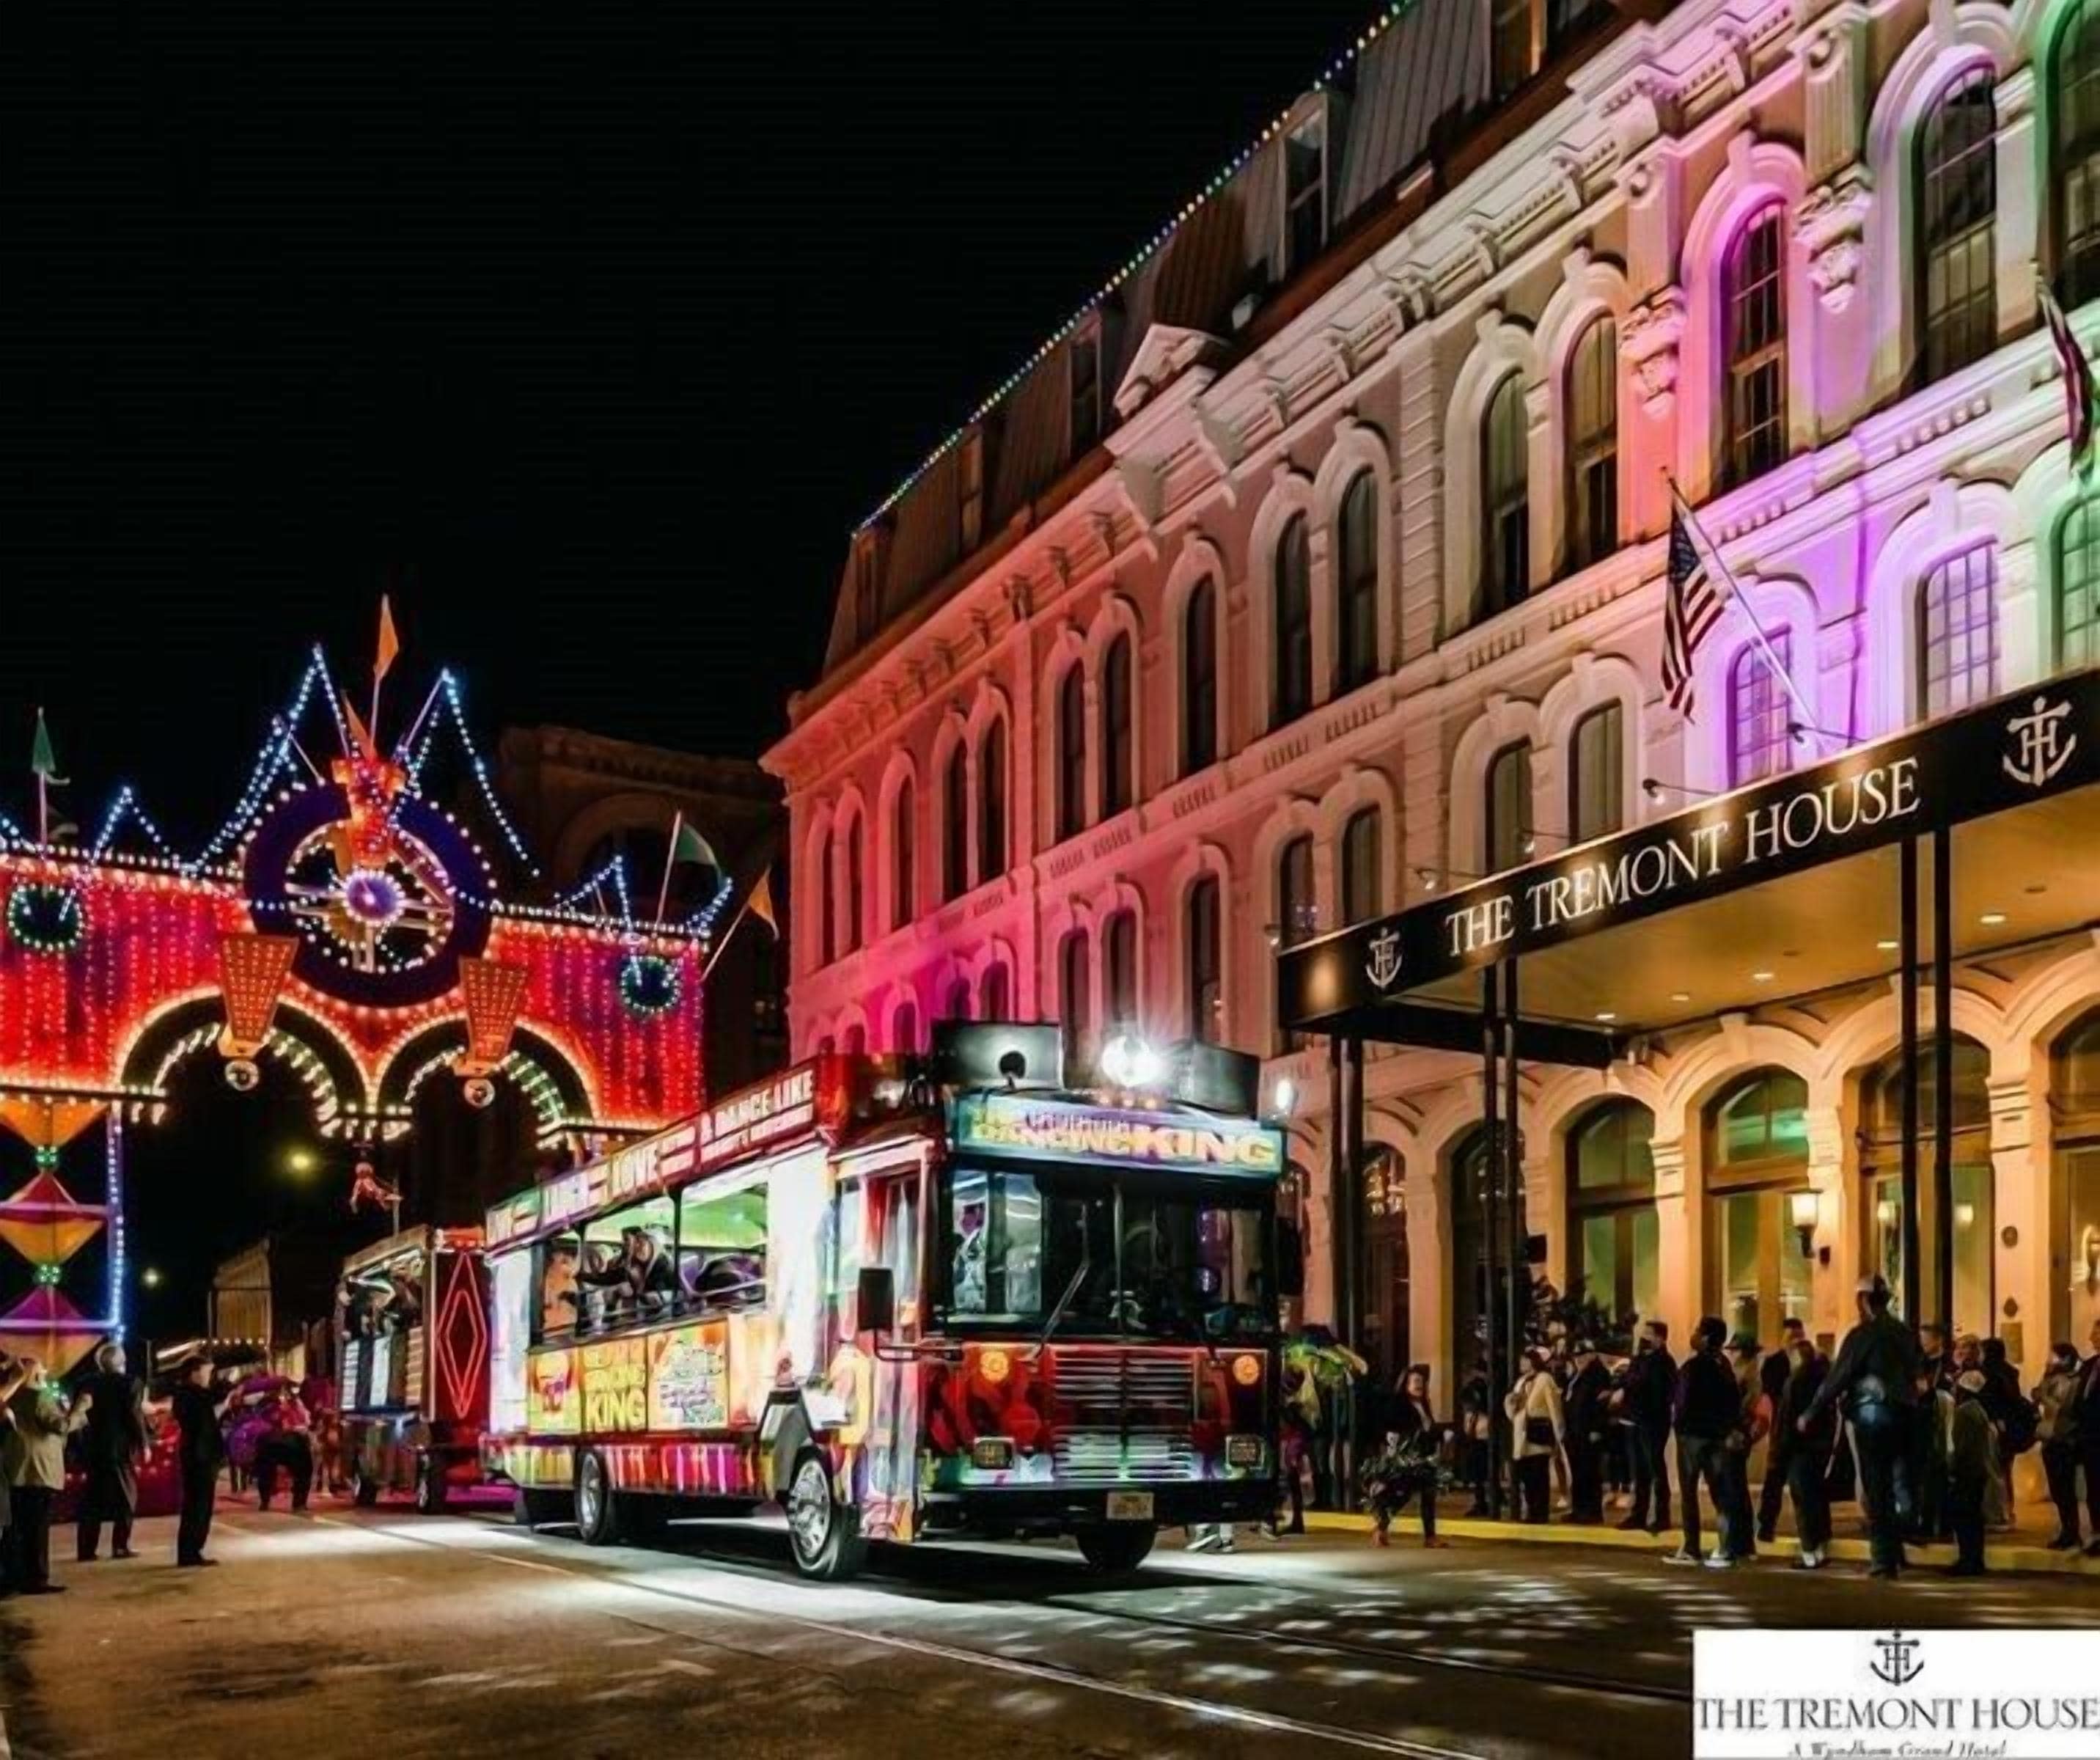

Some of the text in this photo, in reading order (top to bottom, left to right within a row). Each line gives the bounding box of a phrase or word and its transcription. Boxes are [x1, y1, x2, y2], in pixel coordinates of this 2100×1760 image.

[1444, 756, 1921, 957] THE TREMONT HOUSE
[1132, 1123, 1275, 1165] KING
[586, 1387, 646, 1429] KING
